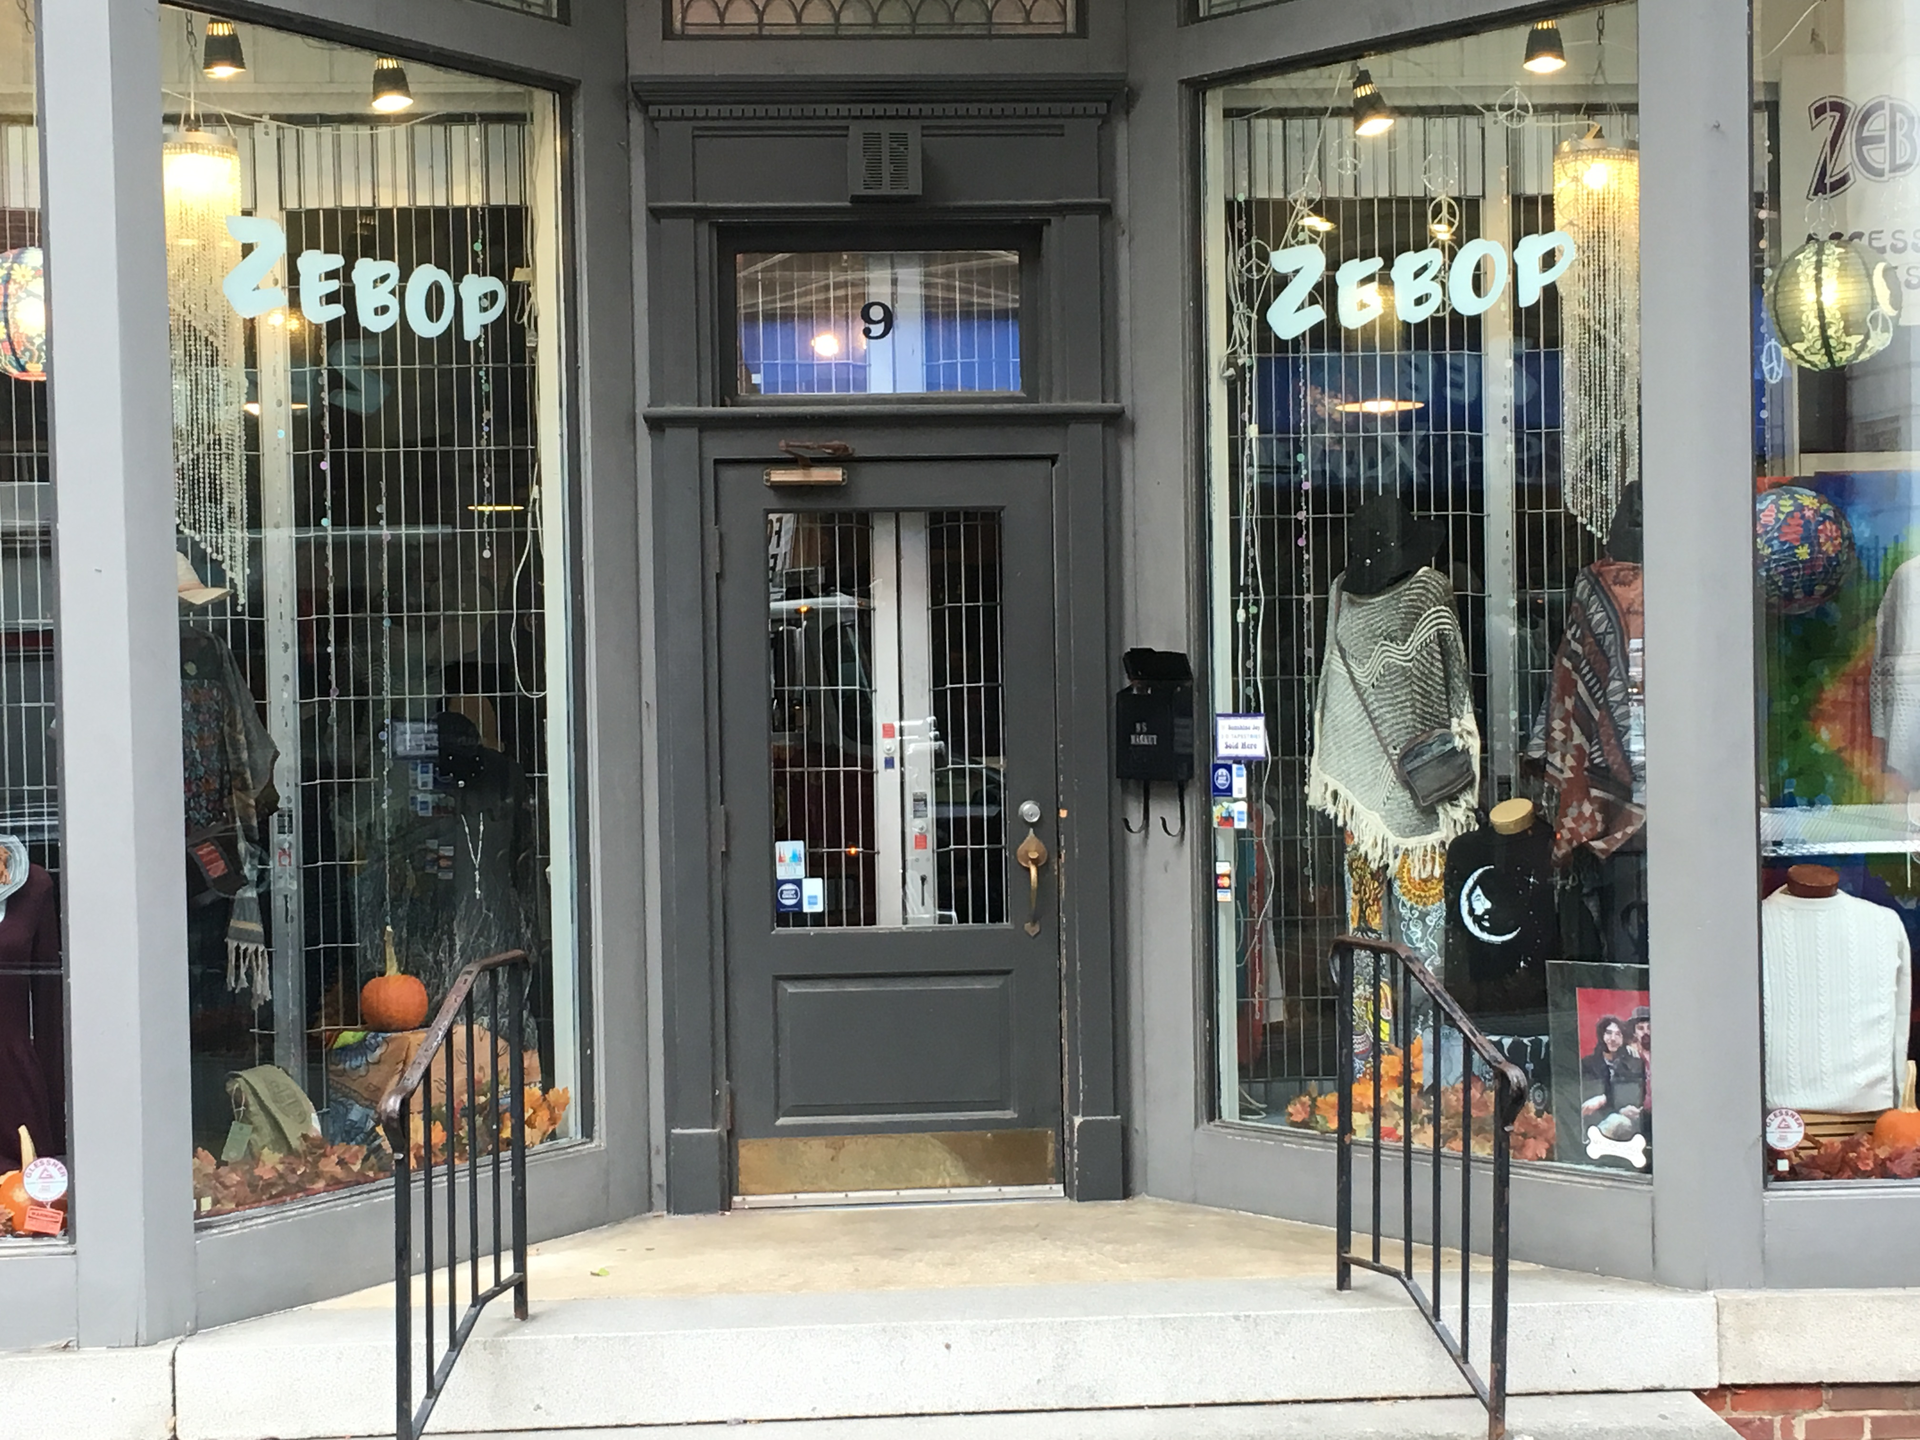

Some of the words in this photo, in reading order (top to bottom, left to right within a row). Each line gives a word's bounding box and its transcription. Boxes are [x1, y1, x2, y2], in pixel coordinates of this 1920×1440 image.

[222, 216, 506, 341] ZEBOP
[1265, 231, 1576, 341] ZEBOP
[860, 301, 894, 341] 9
[1224, 741, 1239, 750] Sold
[1241, 741, 1258, 750] Here
[1766, 1110, 1803, 1129] GLESSNER
[25, 1159, 67, 1179] GLESSNER
